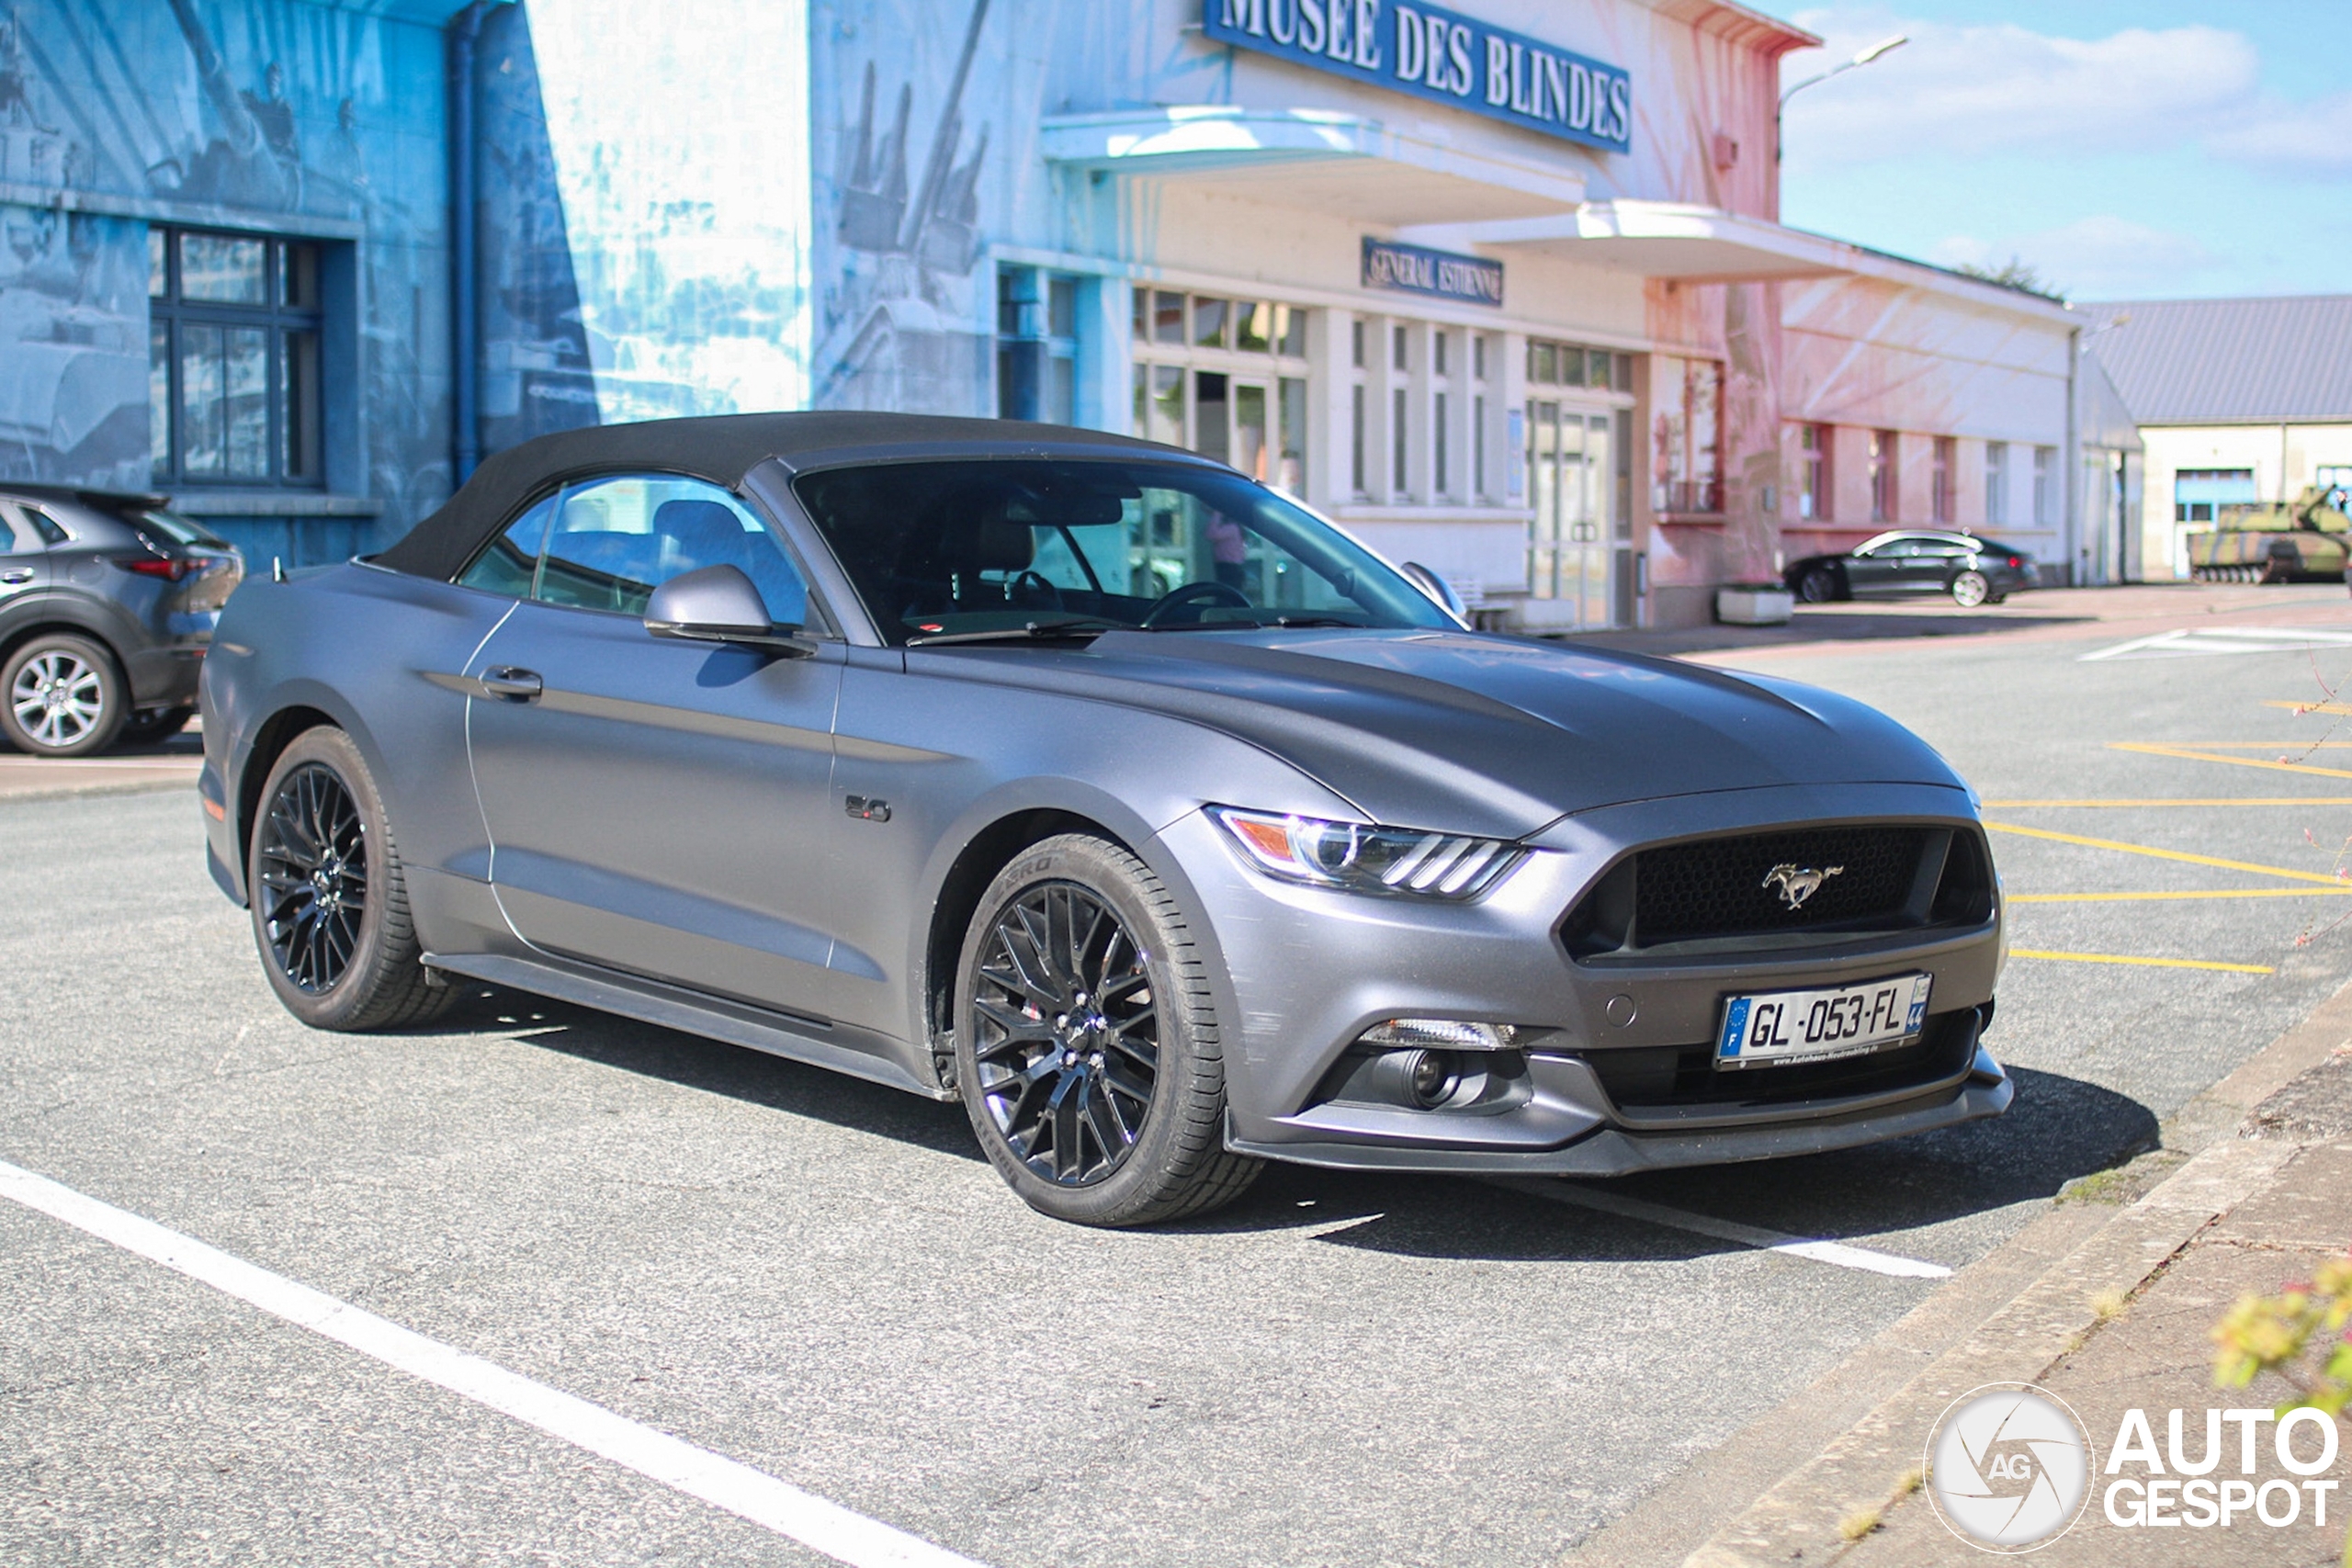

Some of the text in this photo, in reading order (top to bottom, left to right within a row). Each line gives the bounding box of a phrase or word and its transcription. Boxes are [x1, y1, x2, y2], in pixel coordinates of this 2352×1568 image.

[1395, 5, 1473, 97] DES
[1485, 35, 1629, 141] BLINDES
[1749, 988, 1899, 1047] GL-053-FL
[1907, 1003, 1923, 1027] 44
[1727, 1032, 1737, 1048] F
